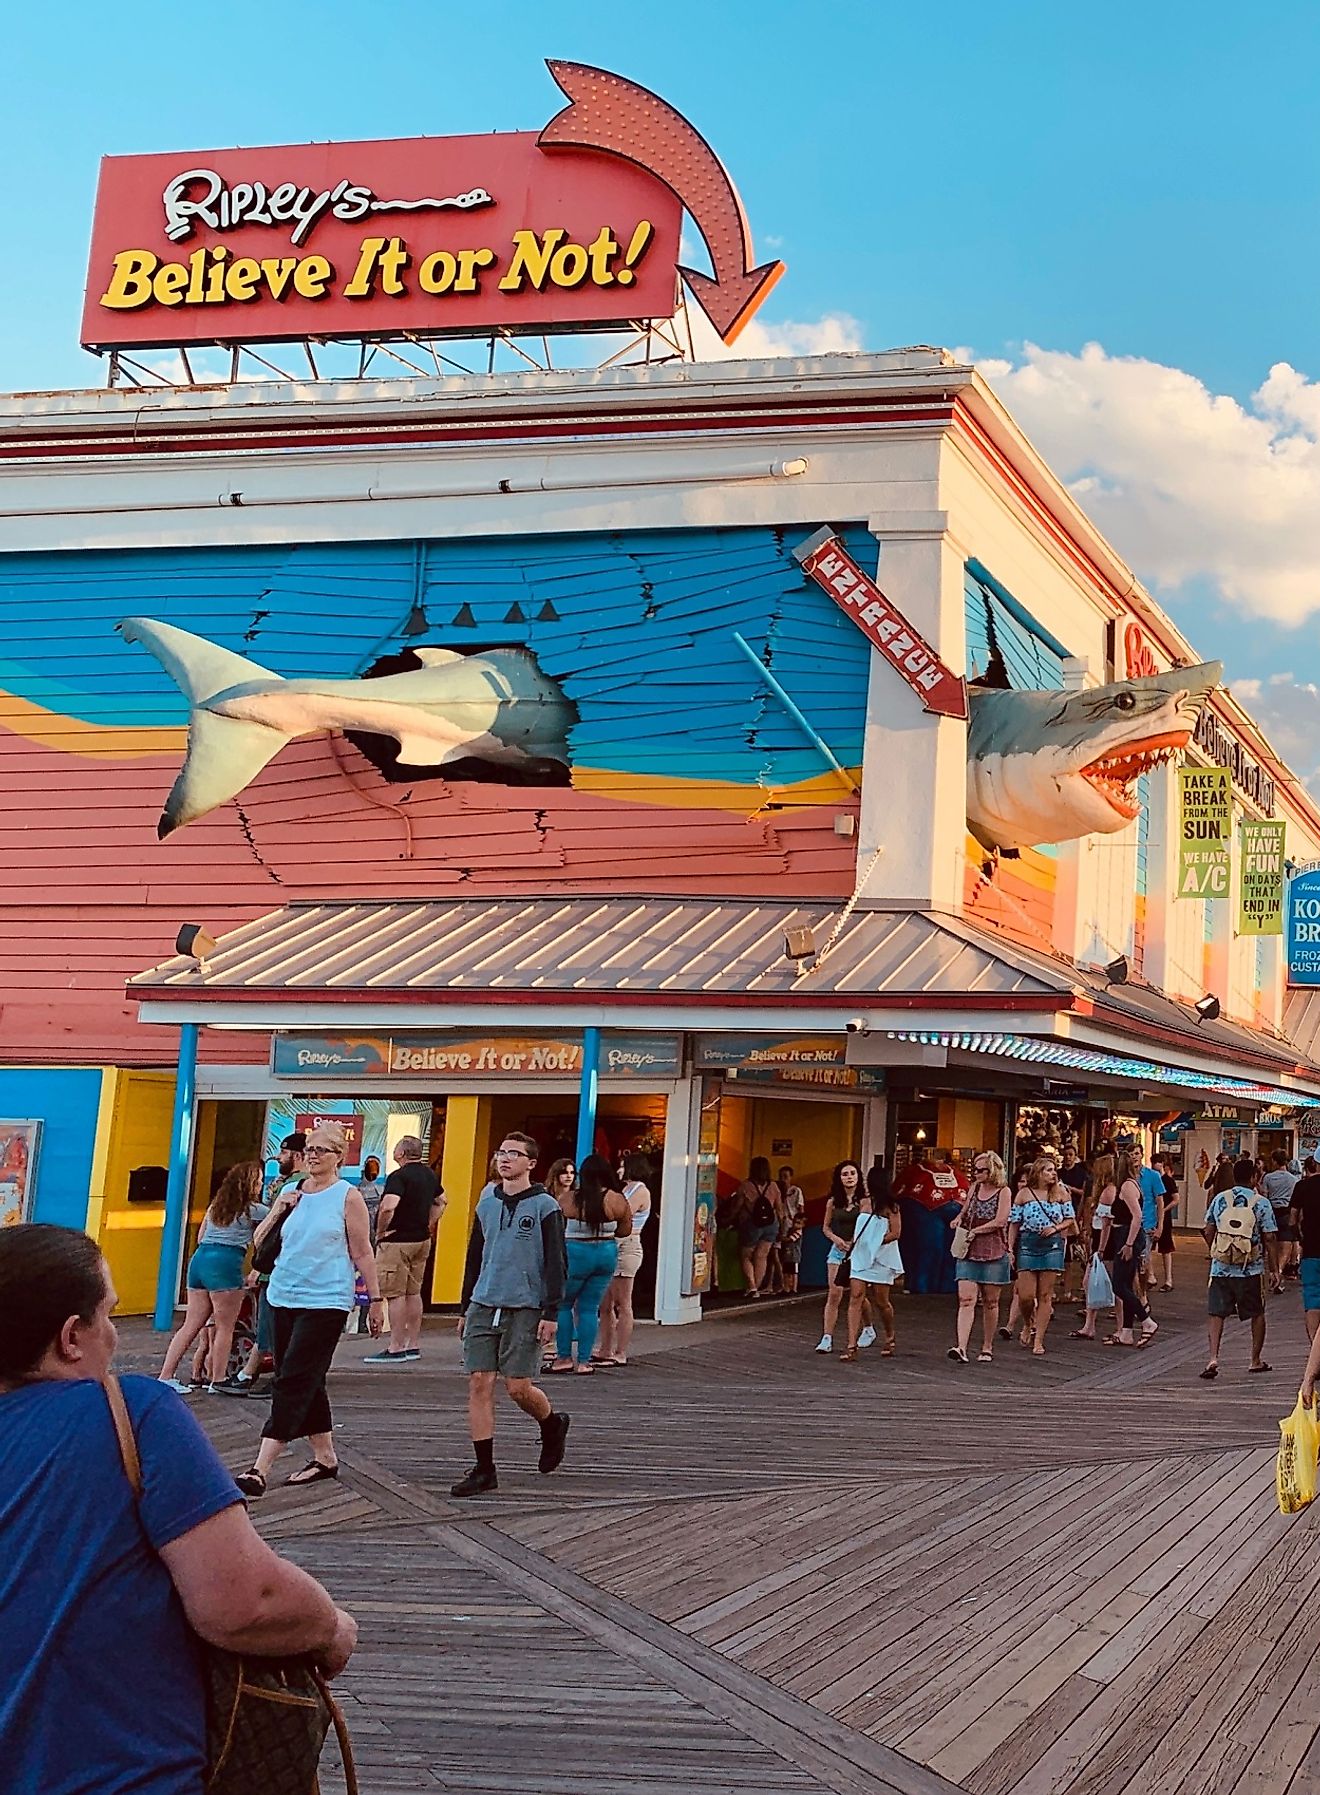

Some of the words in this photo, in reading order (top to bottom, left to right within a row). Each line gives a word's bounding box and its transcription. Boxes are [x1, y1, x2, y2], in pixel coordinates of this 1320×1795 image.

[101, 249, 332, 310] Believe
[343, 236, 411, 298] It
[419, 246, 494, 295] or
[500, 219, 652, 292] Not!
[817, 552, 944, 691] ENTRANCE
[1183, 775, 1214, 789] TAKE
[1219, 775, 1227, 788] A
[1183, 790, 1228, 806] BREAK
[1183, 808, 1209, 818] FROM
[1211, 807, 1228, 818] THE
[1244, 827, 1260, 837] WE
[1261, 827, 1283, 837] ONLY
[1247, 838, 1280, 853] HAVE
[1184, 852, 1200, 864] WE
[1201, 852, 1228, 864] HAVE
[1246, 855, 1280, 873] FUN
[1295, 863, 1316, 877] PIER
[1182, 864, 1227, 893] A/C
[1243, 875, 1256, 885] ON
[1257, 875, 1281, 886] DAYS
[1249, 886, 1275, 897] THAT
[1243, 900, 1265, 912] END
[1268, 900, 1280, 912] IN
[392, 1047, 471, 1071] Believe
[474, 1047, 499, 1071] It
[500, 1054, 523, 1070] or
[527, 1046, 579, 1070] Not!
[749, 1050, 788, 1062] Believe
[789, 1050, 801, 1061] It
[801, 1053, 814, 1062] or
[815, 1050, 838, 1062] Not!
[1201, 1102, 1238, 1118] ATM
